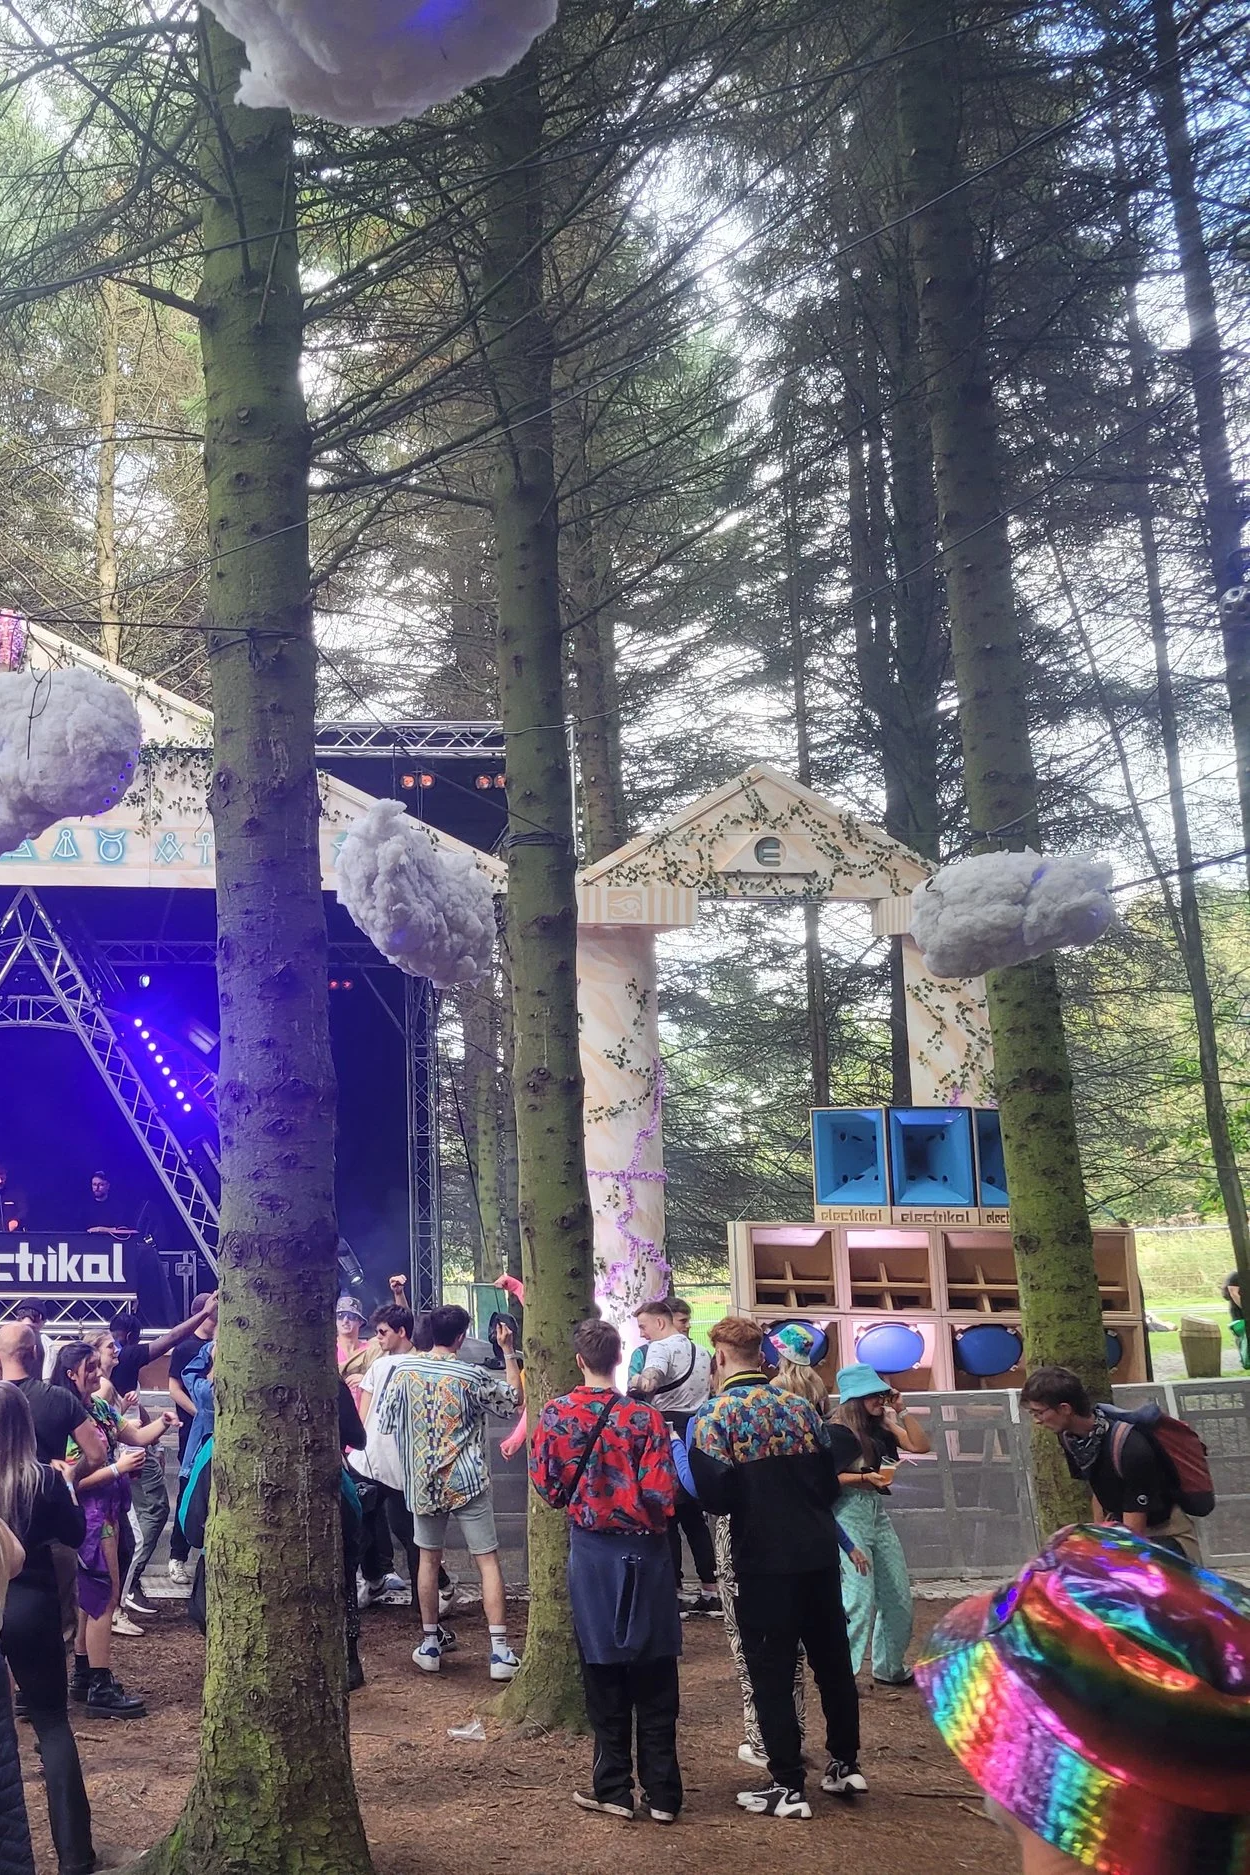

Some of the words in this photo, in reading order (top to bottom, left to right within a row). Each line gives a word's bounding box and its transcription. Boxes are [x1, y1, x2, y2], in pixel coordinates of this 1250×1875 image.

[754, 836, 781, 867] E
[821, 1208, 882, 1222] electrikal
[900, 1210, 970, 1223] electrikal
